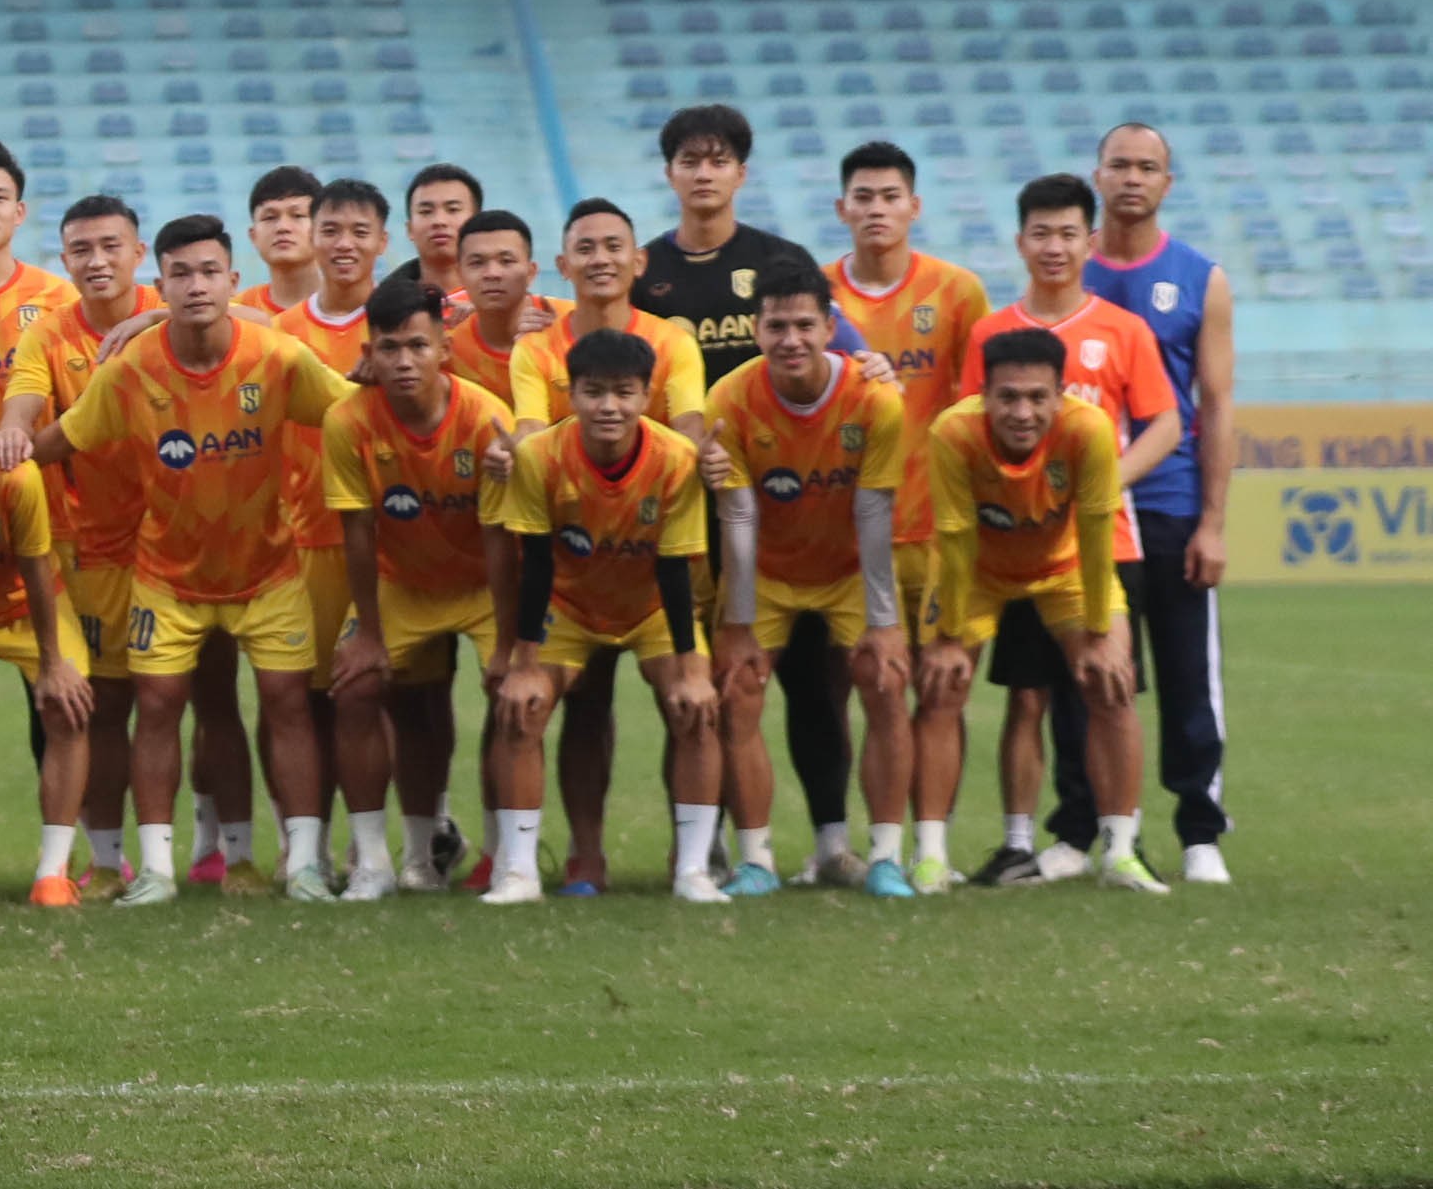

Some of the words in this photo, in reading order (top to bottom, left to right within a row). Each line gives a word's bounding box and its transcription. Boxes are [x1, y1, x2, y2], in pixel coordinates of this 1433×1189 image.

[698, 314, 757, 341] AAN
[882, 348, 936, 370] AN
[201, 427, 263, 454] AAN
[127, 605, 156, 651] 20
